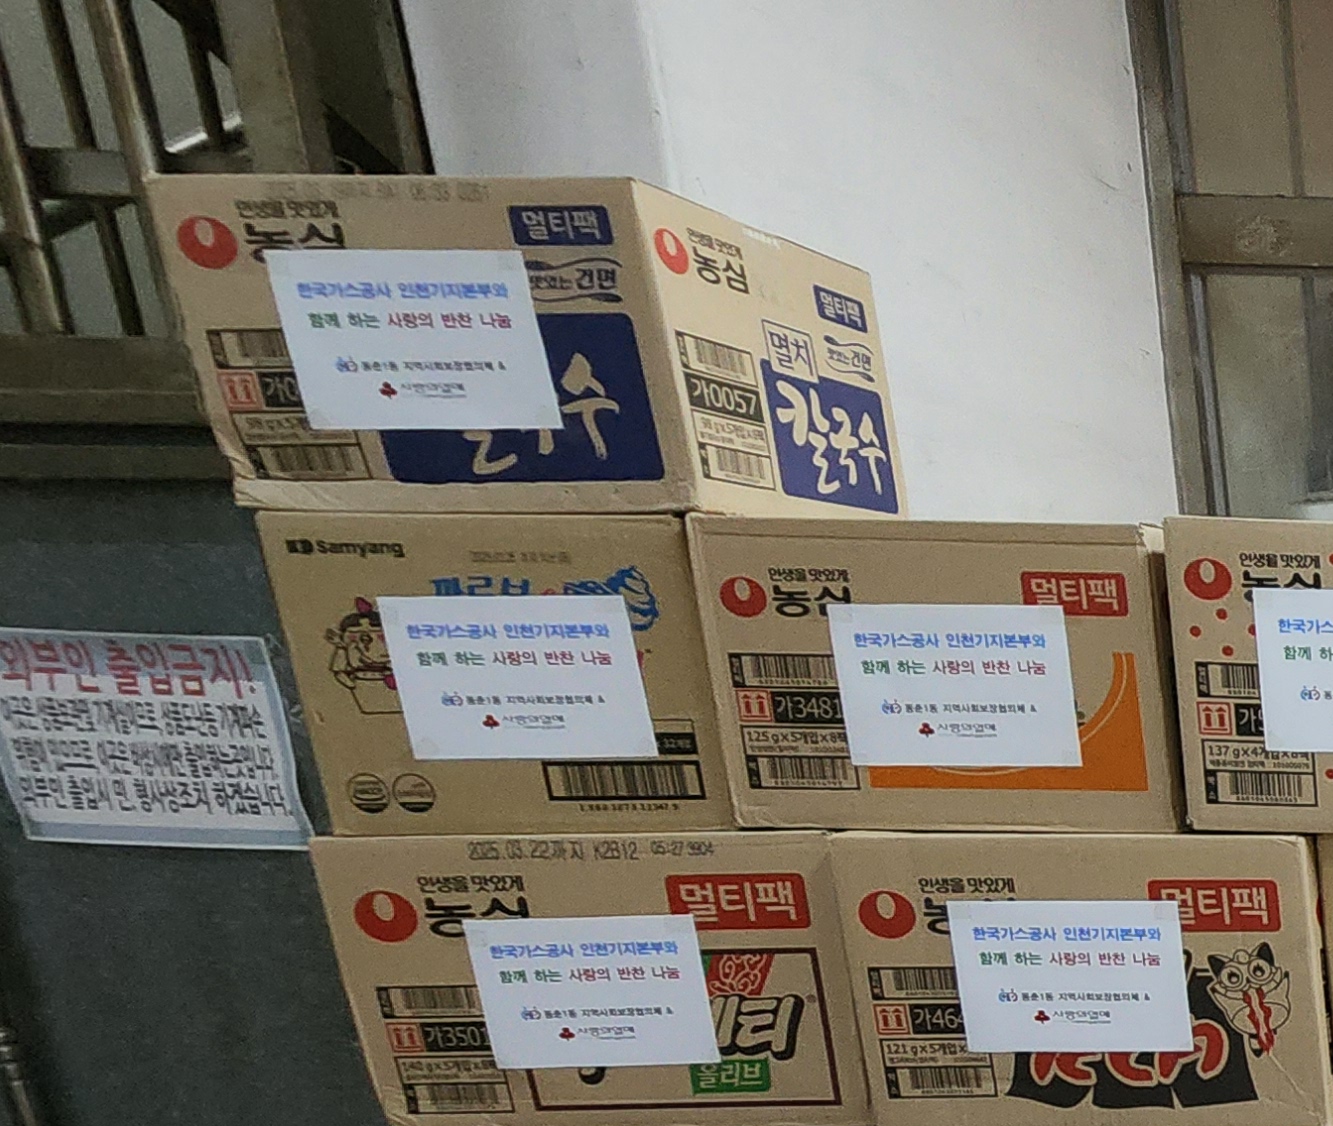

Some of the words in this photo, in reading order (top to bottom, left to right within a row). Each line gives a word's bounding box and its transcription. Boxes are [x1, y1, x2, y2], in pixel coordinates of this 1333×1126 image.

[521, 209, 600, 241] 멀티팩
[575, 267, 618, 291] 건면
[691, 244, 750, 295] 농심
[819, 290, 863, 330] 멀티팩
[767, 330, 814, 377] 멸치
[689, 378, 758, 417] 가0057
[775, 379, 887, 496] 칼국수
[315, 539, 406, 558] Samyang
[1238, 552, 1278, 569] 인생을
[1279, 553, 1322, 570] 맛있게
[1029, 577, 1119, 611] 멀티팩
[404, 622, 498, 640] 한국가스공사
[501, 622, 610, 640] 인천기지본부와
[852, 631, 940, 649] 한국가스공사
[944, 631, 1046, 649] 인천기지본부와
[415, 650, 449, 667] 함께
[452, 649, 486, 667] 하는
[491, 649, 539, 667] 사랑의
[542, 649, 576, 666] 반찬
[579, 649, 613, 666] 나눔
[1282, 643, 1312, 662] 함께
[859, 658, 891, 675] 함께
[895, 658, 927, 675] 하는
[931, 658, 976, 676] 사랑의
[980, 658, 1012, 676] 반찬
[1015, 658, 1047, 676] 나눔
[679, 880, 799, 922] 멀티팩
[971, 925, 1058, 942] 한국가스공사
[1061, 925, 1162, 942] 인천기지본부와
[488, 942, 575, 960] 한국가스공사
[578, 939, 679, 958] 인천기지본부와
[977, 950, 1009, 966] 함께
[1012, 950, 1043, 967] 하는
[1048, 950, 1092, 967] 사랑의
[1097, 951, 1126, 967] 반찬
[1131, 950, 1161, 968] 나눔
[497, 968, 529, 985] 함께
[532, 967, 563, 983] 하는
[567, 966, 612, 983] 사랑의
[615, 964, 647, 981] 반찬
[649, 964, 681, 980] 나눔
[696, 1064, 763, 1088] 올리브
